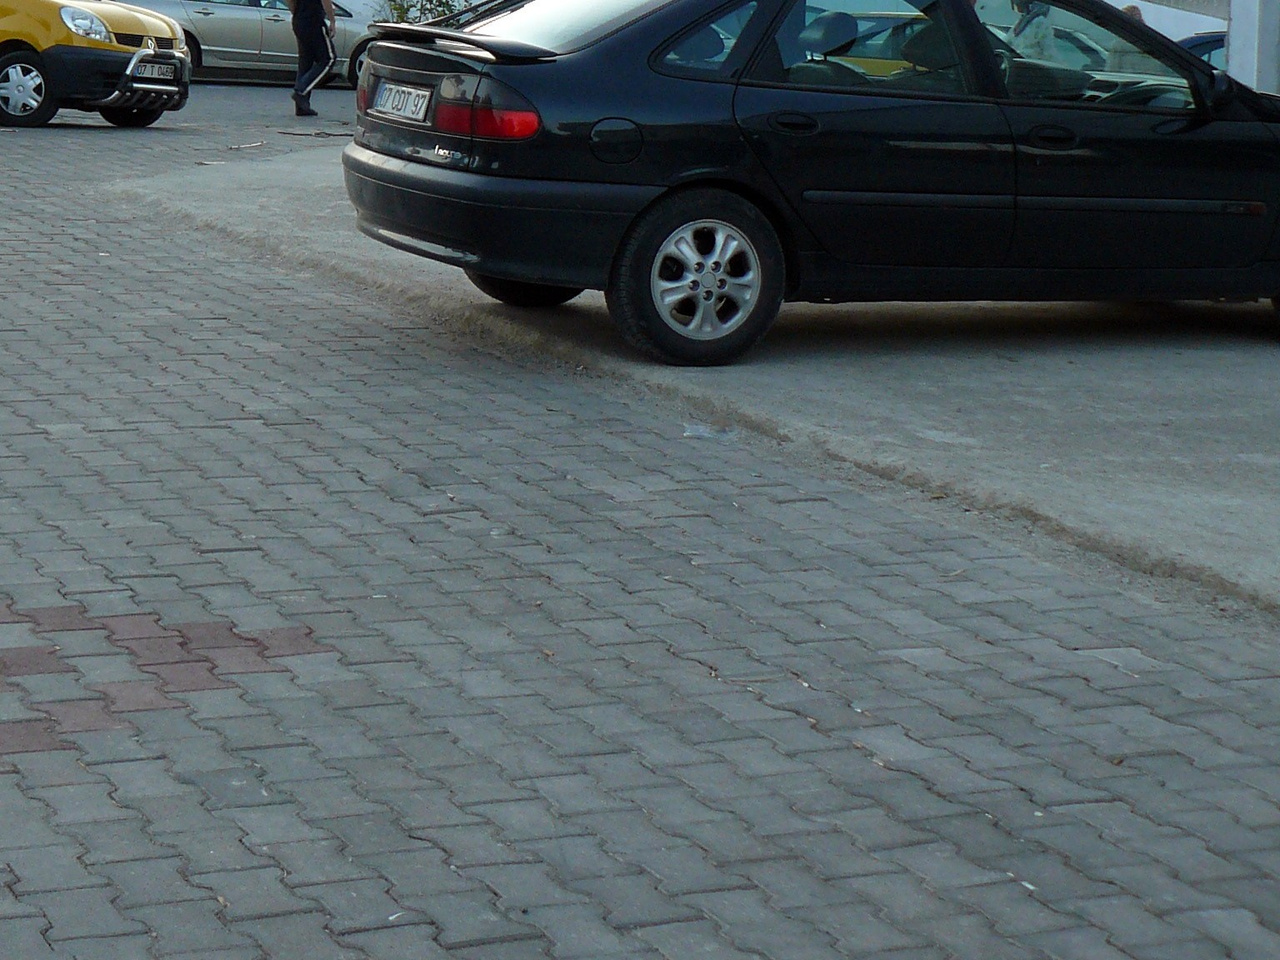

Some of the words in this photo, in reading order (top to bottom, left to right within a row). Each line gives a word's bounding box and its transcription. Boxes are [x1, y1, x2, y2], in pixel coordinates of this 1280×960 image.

[137, 64, 147, 76] 07
[150, 65, 155, 76] T
[392, 88, 412, 113] CDT
[411, 93, 427, 116] 97
